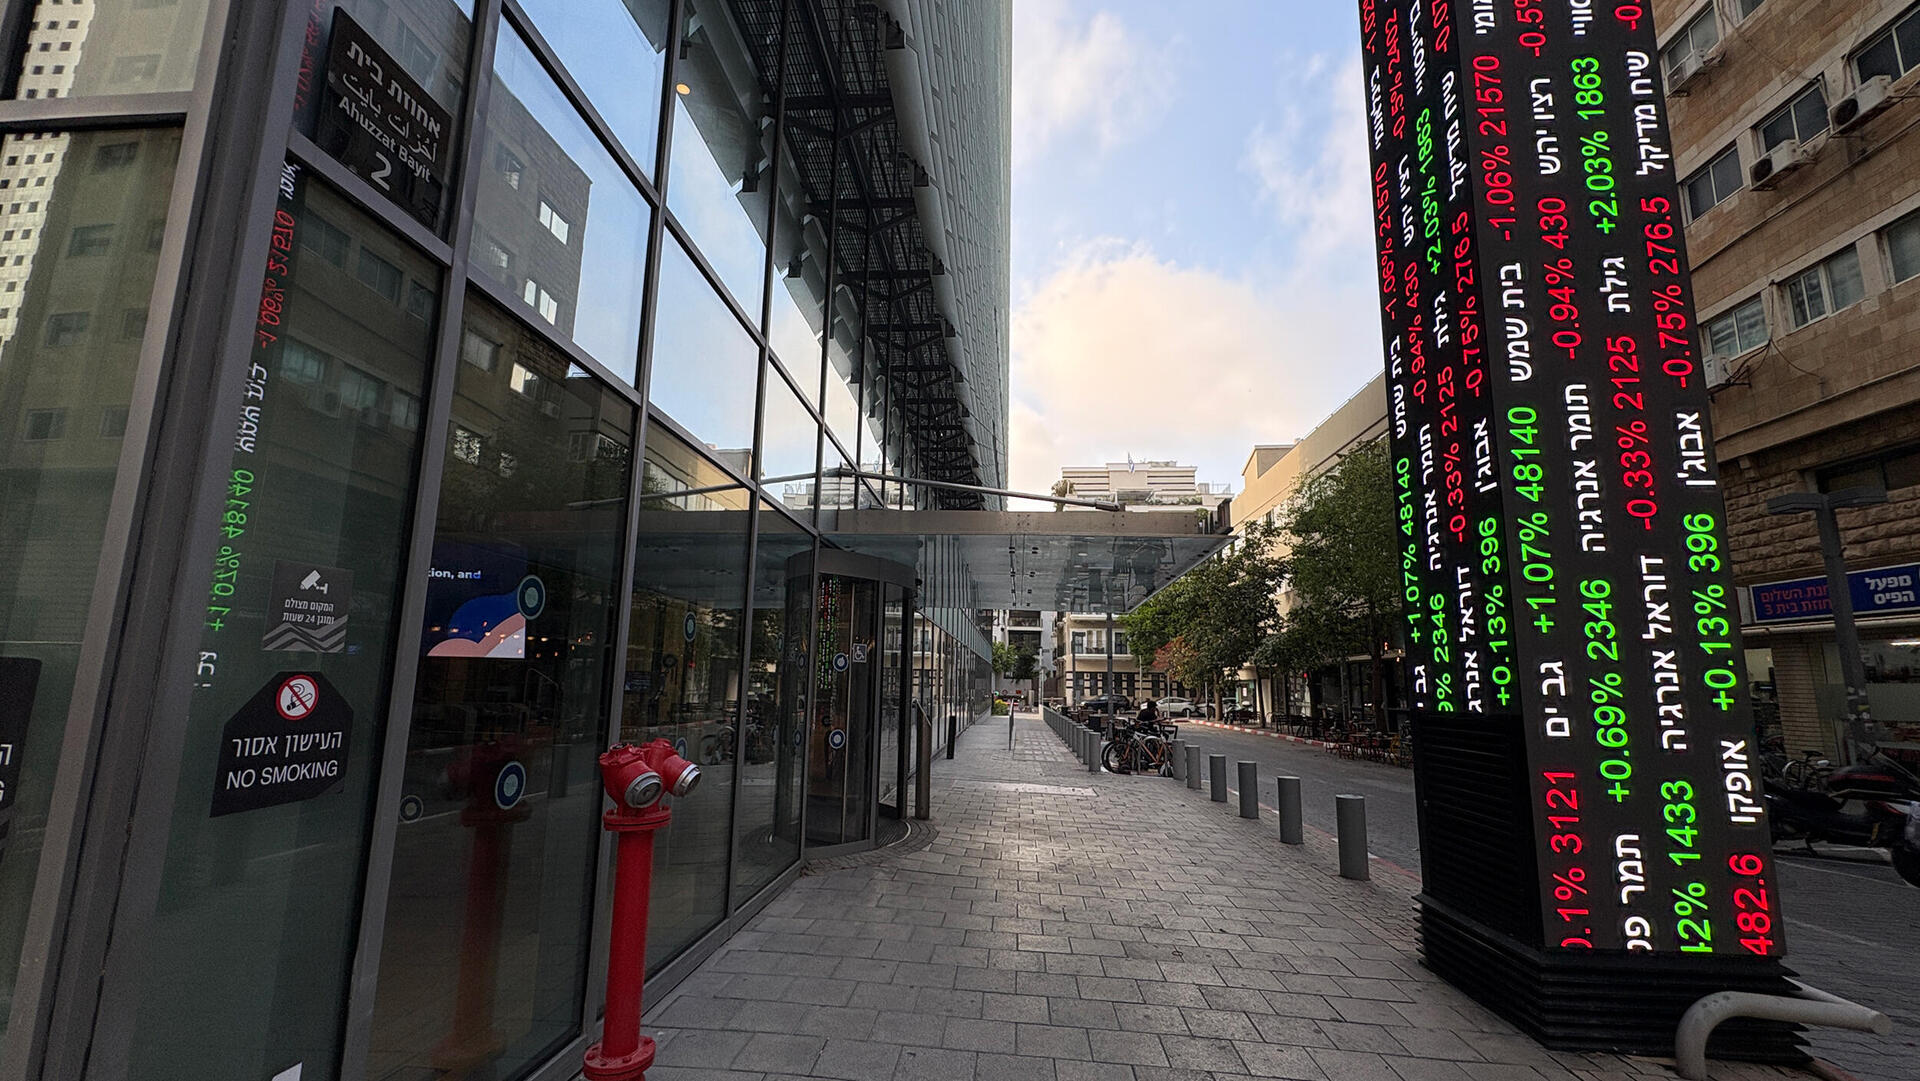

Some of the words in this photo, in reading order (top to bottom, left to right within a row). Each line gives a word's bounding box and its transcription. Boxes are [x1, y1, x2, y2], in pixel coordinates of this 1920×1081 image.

[1384, 8, 1402, 75] 2402
[1472, 0, 1496, 35] ומי
[347, 41, 383, 86] בית
[1441, 70, 1459, 122] שיח
[1472, 55, 1507, 137] 21570
[1571, 57, 1605, 121] 1863
[1626, 50, 1653, 95] שיח
[388, 80, 441, 139] אחוזת
[1370, 64, 1385, 151] בינלאומי
[1388, 71, 1406, 140] -0.5%
[1530, 78, 1555, 120] רציו
[339, 96, 396, 153] Ahuzzat
[398, 145, 431, 182] Bayit
[370, 152, 392, 191] 2
[1415, 107, 1434, 174] 1863
[1446, 120, 1467, 202] מדיקל
[1535, 129, 1561, 175] יהש
[1633, 104, 1670, 176] מדיקל
[1375, 161, 1392, 237] 21570
[1480, 145, 1516, 241] -1.06%
[1579, 130, 1619, 234] +2.03%
[1401, 204, 1415, 248] יהש
[1420, 175, 1442, 275] +2.03%
[1451, 211, 1474, 294] 276.5
[1537, 197, 1569, 250] 430
[1640, 196, 1679, 275] 276.5
[1380, 237, 1397, 320] -1.06%
[1404, 261, 1420, 308] 430
[1499, 262, 1525, 309] בית
[1543, 258, 1582, 360] -0.94%
[1599, 256, 1631, 313] גילת
[1432, 290, 1450, 349] גילת
[1458, 295, 1483, 398] -0.75%
[1505, 317, 1533, 382] שמש
[1651, 284, 1694, 388] -0.75%
[1390, 335, 1403, 379] בית
[1407, 314, 1427, 404] -0.94%
[1605, 335, 1644, 411] 2125
[1393, 383, 1407, 440] שמש
[1437, 365, 1458, 437] 2125
[1564, 384, 1593, 451] תומר
[1419, 423, 1434, 486] תומר
[1473, 417, 1498, 493] אבוג'ן
[1507, 406, 1544, 503] 48140
[1615, 420, 1658, 531] -0.33%
[1676, 412, 1717, 486] אבוג'ן
[1396, 457, 1414, 536] 48140
[1443, 442, 1466, 543] -0.33%
[1572, 459, 1606, 552] אנרגיה
[1424, 489, 1442, 571] אנרגיה
[1478, 517, 1501, 575] 396
[1683, 513, 1721, 573] 396
[284, 597, 308, 610] מצולם
[310, 601, 334, 613] המקום
[457, 570, 481, 579] and
[1402, 543, 1421, 643] +1.07%
[1456, 566, 1476, 643] דוראל
[1517, 512, 1556, 634] +1.07%
[1640, 554, 1673, 640] דוראל
[1760, 588, 1802, 602] השלום
[1864, 574, 1912, 591] מפעל
[1873, 590, 1915, 605] הפיס
[282, 612, 304, 622] שעות
[305, 614, 315, 623] 24
[1429, 593, 1450, 663] 2346
[1579, 579, 1619, 661] 2346
[1764, 604, 1774, 616] 3
[1775, 602, 1798, 615] בית
[1414, 664, 1427, 694] גב
[1484, 584, 1512, 706] +0.13%
[1539, 660, 1566, 697] גב
[1691, 584, 1737, 711] +0.13%
[1544, 707, 1571, 737] ים
[1651, 650, 1687, 750] אנרגיה
[232, 735, 278, 758] אסור
[285, 731, 343, 758] העישון
[1589, 672, 1632, 803] +0.69%
[226, 768, 256, 790] NO
[260, 760, 338, 785] SMOKING
[1720, 740, 1764, 823] אופקו
[1543, 771, 1583, 855] 3121
[1660, 780, 1701, 866] 1433
[1615, 834, 1646, 904] תמר
[1728, 854, 1774, 954] 482.6
